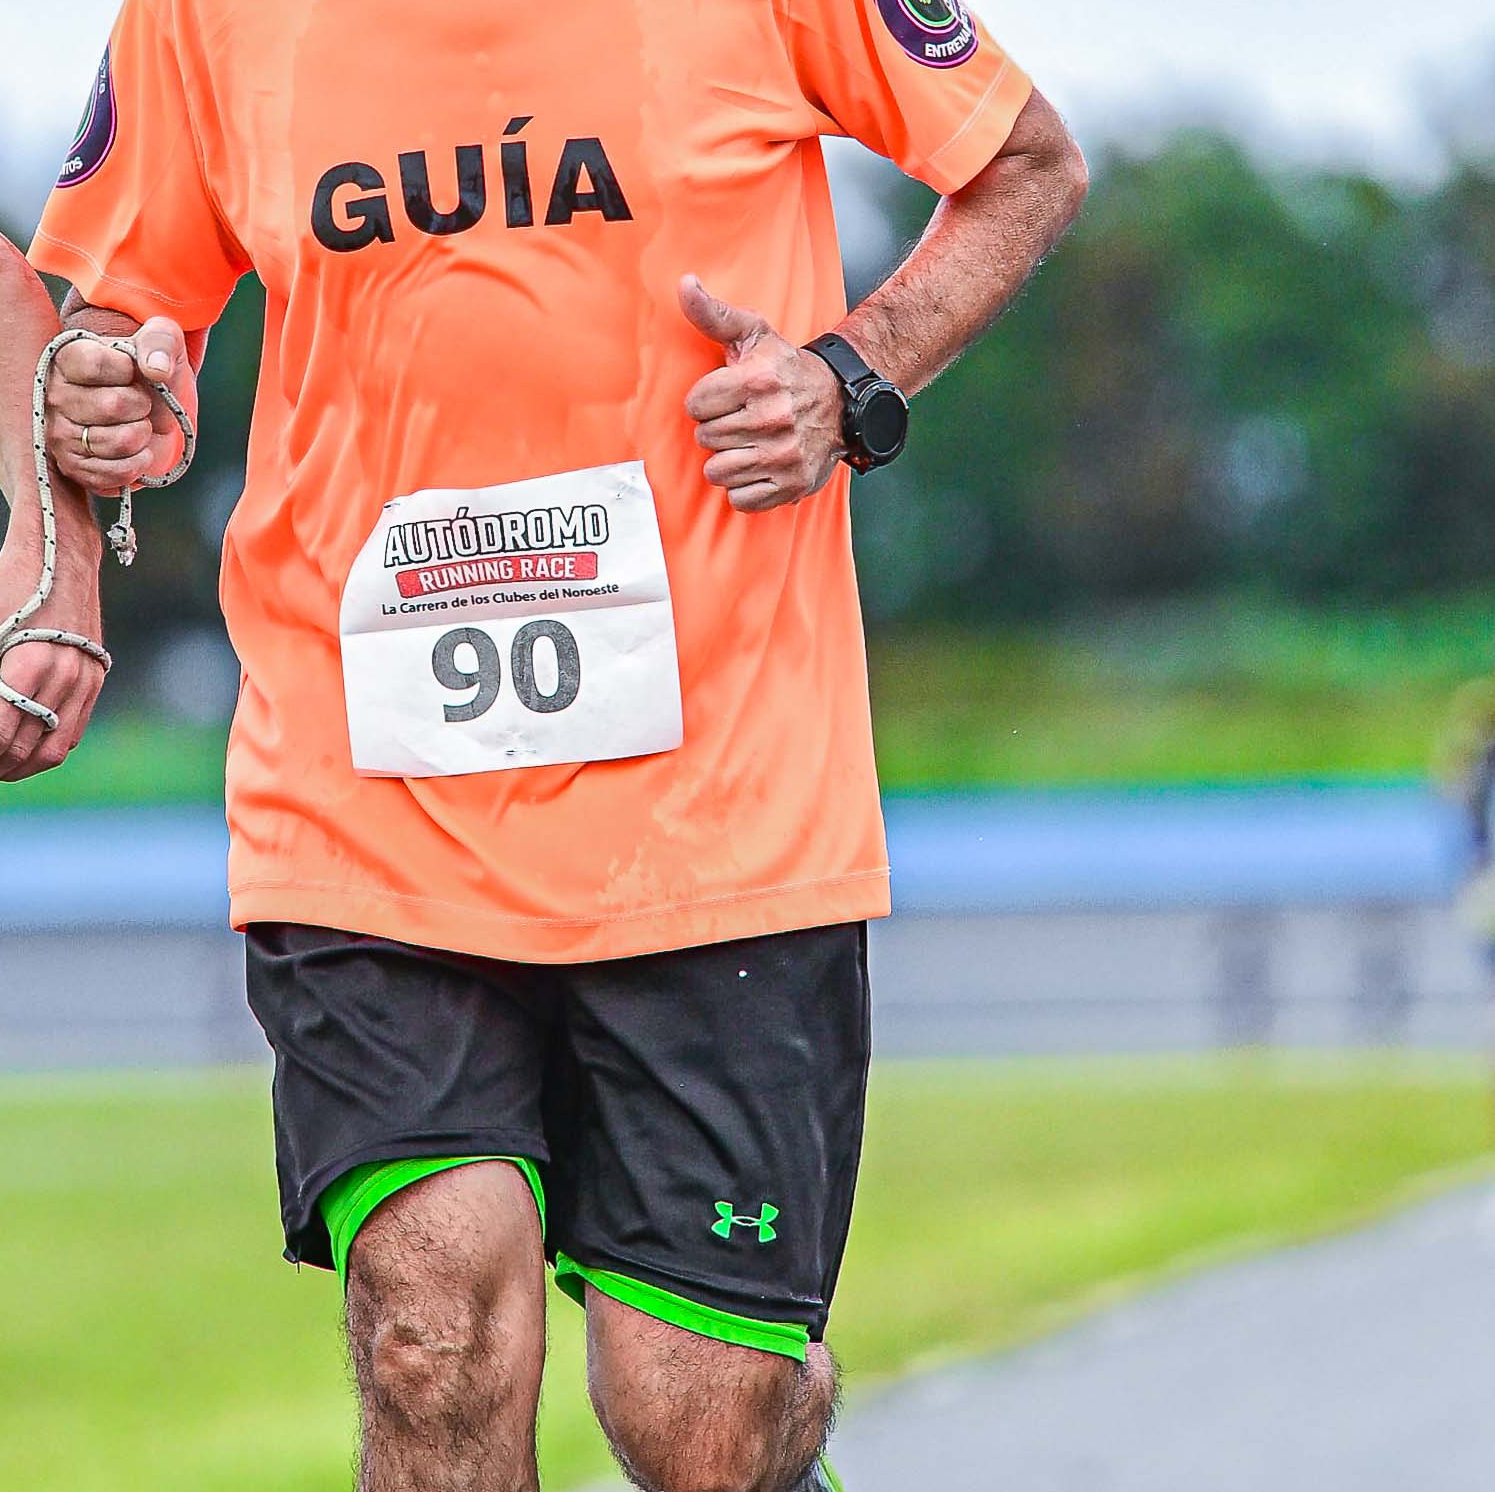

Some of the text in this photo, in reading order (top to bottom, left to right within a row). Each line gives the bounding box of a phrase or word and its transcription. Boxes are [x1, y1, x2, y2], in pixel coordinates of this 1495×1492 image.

[311, 116, 634, 252] GUÍA
[384, 505, 609, 567] AUTÓDROMO
[382, 584, 619, 615] La Carrera de los Clubes del Noroeste
[418, 557, 576, 592] RUNNING RACE
[432, 620, 581, 723] 90
